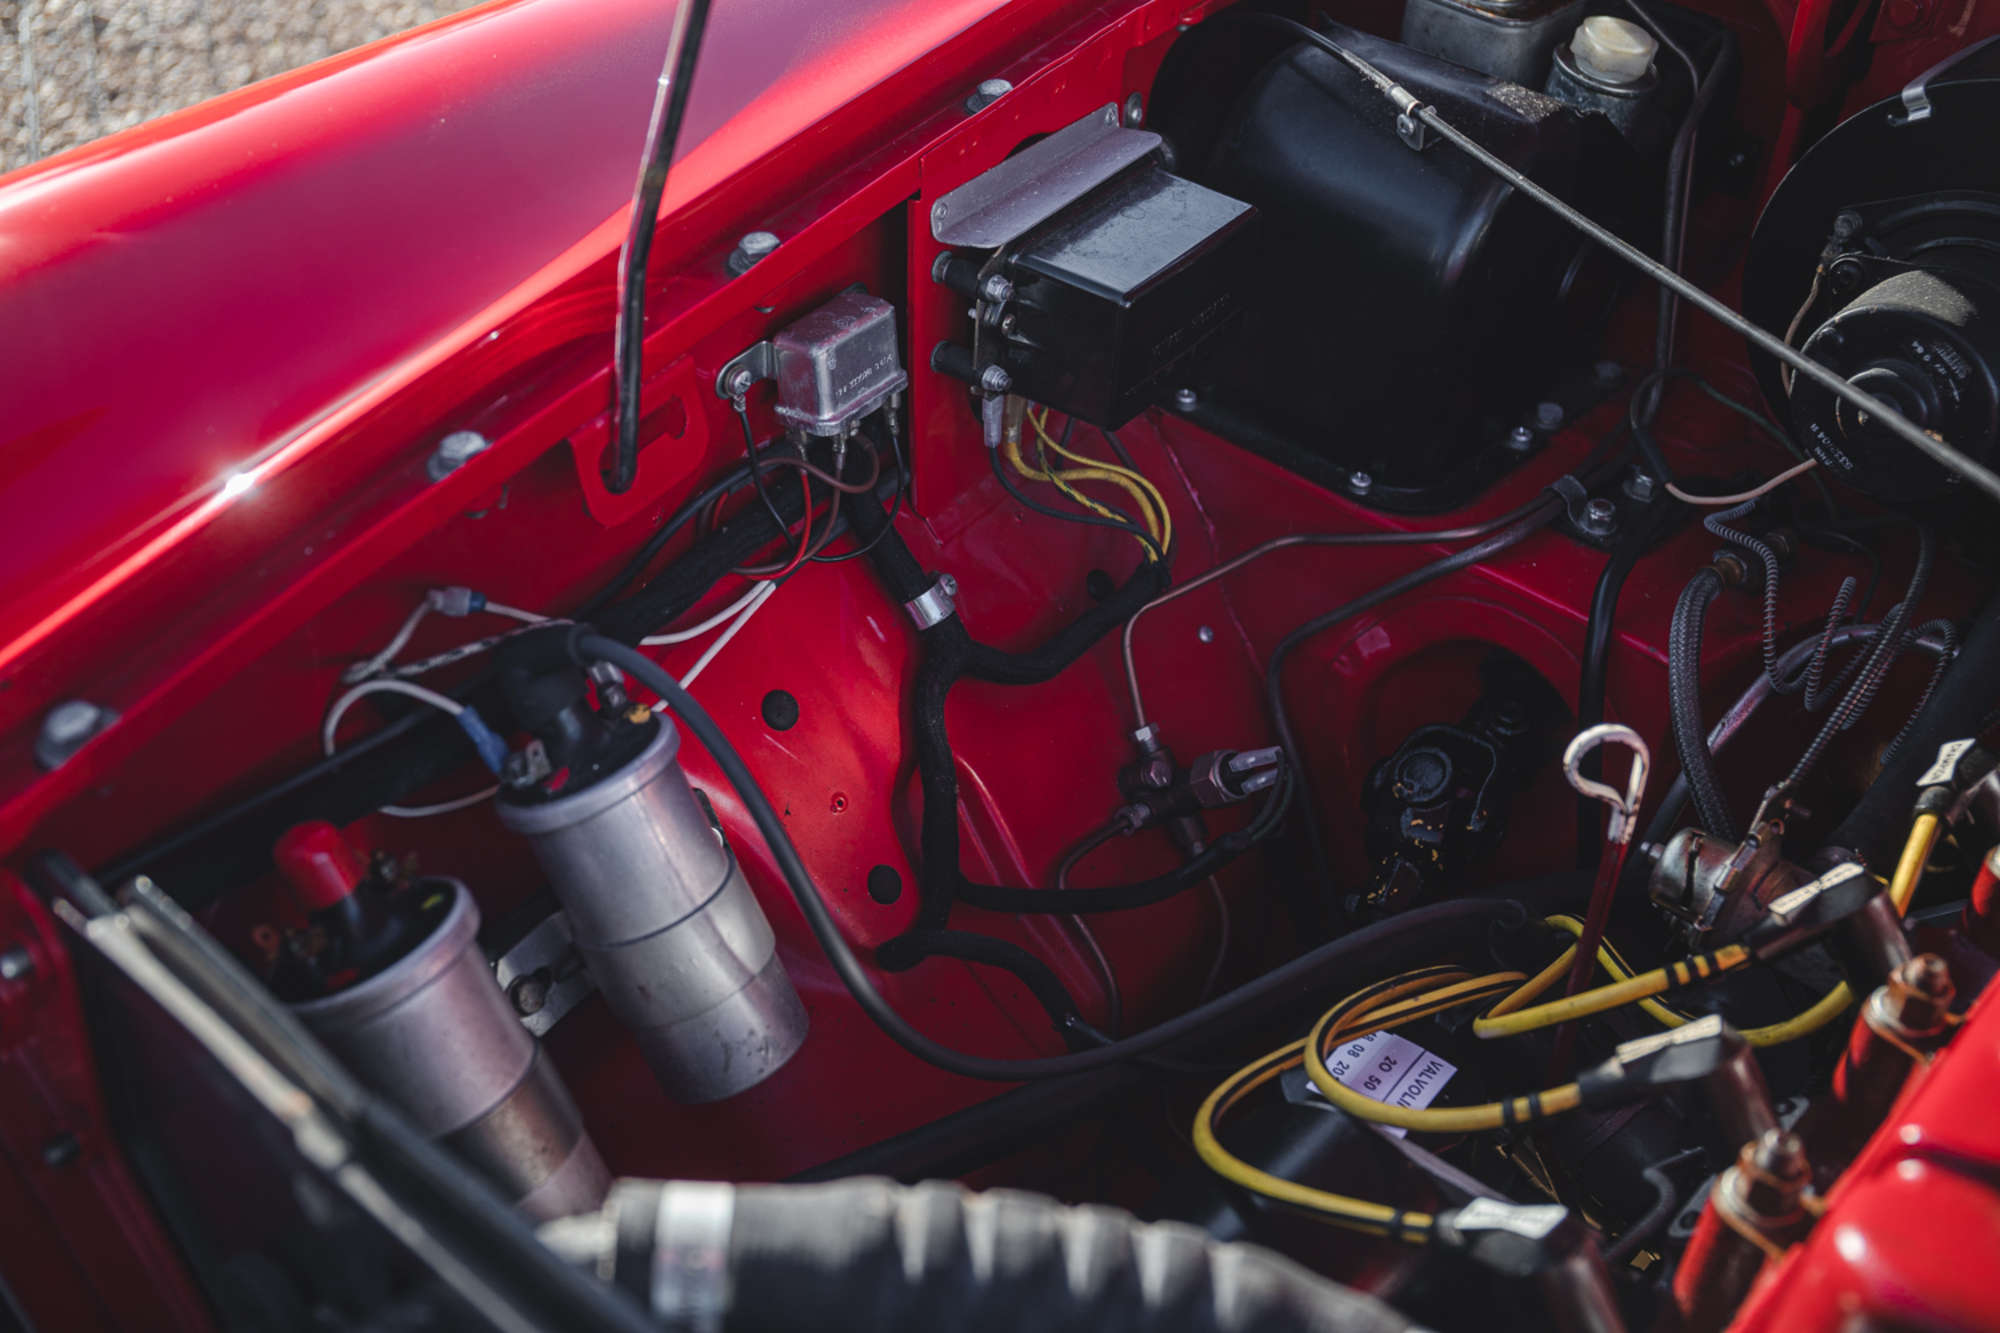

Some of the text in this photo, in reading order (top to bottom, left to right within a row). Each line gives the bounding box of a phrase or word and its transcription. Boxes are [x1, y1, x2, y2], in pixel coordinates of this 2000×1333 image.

[1347, 1044, 1365, 1058] 08
[1332, 1060, 1350, 1080] 20
[1363, 1056, 1397, 1091] 20 50
